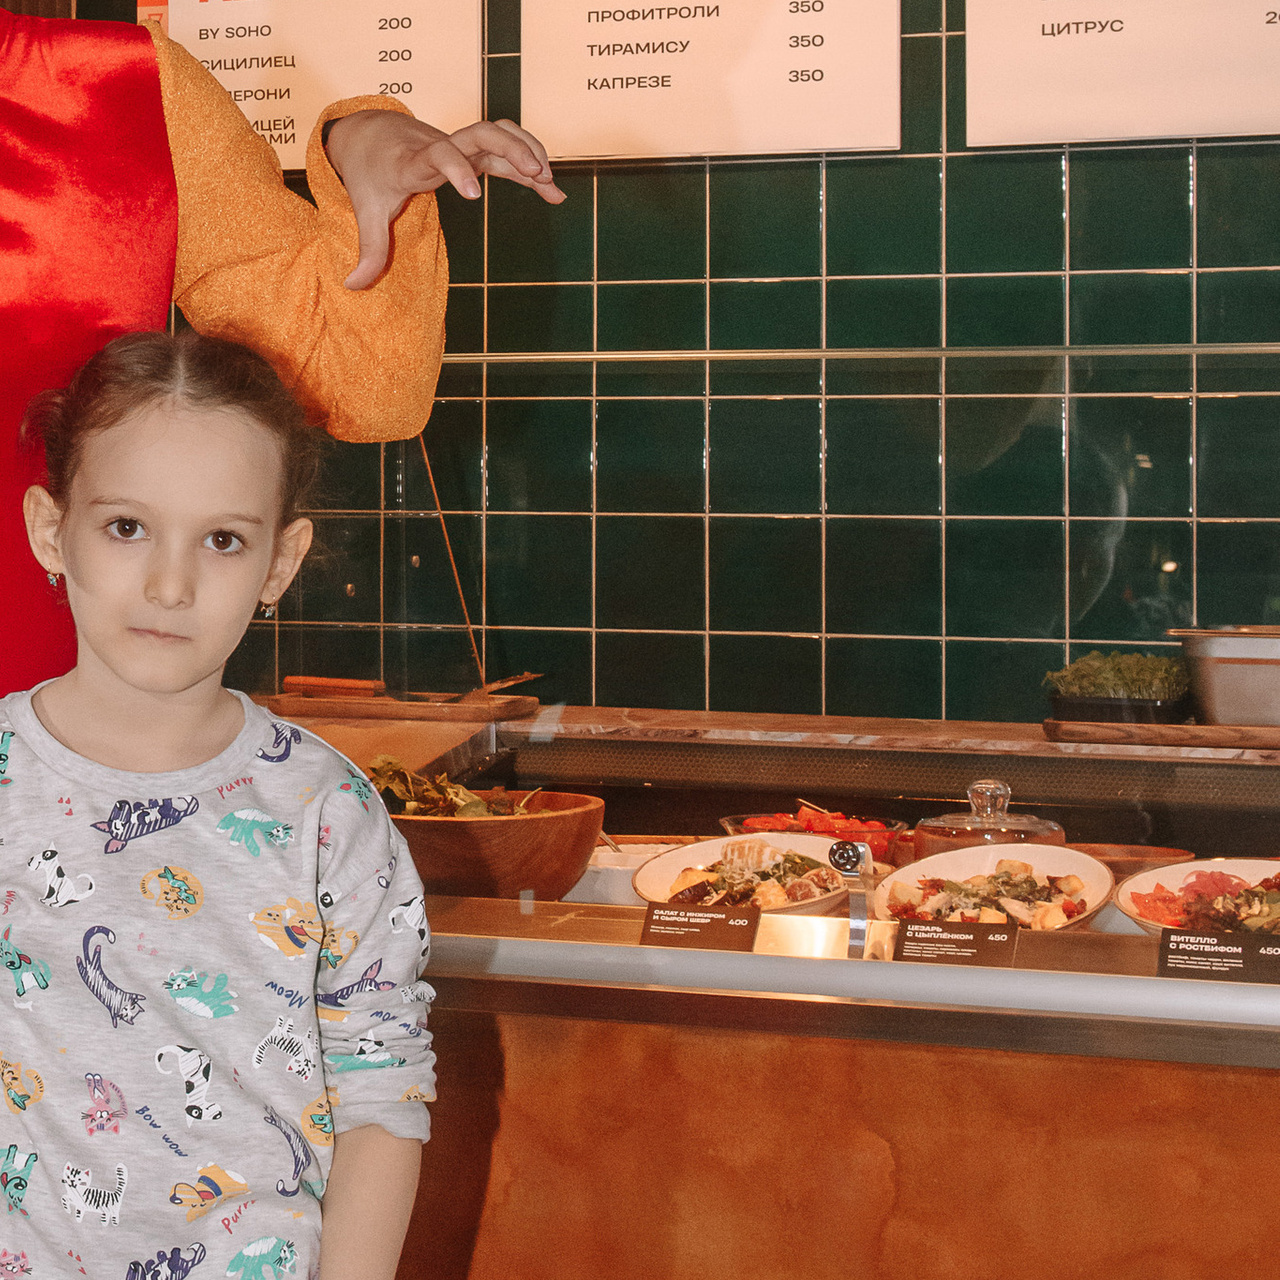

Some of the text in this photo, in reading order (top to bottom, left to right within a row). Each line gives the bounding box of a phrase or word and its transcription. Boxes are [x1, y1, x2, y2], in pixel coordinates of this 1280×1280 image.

[788, 0, 825, 13] 350
[587, 4, 720, 24] ПРОФИТРОЛИ
[378, 17, 412, 30] 200
[1041, 19, 1124, 37] ЦИТРУС
[198, 25, 272, 40] BY SOHO
[587, 39, 691, 57] ТИРАМИСУ
[788, 34, 825, 48] 350
[378, 49, 412, 62] 200
[200, 55, 296, 71] СИЦИЛИЕЦ
[587, 74, 672, 91] КАПРЕЗЕ
[788, 68, 825, 83] 350
[228, 88, 291, 102] ЕРОНИ
[379, 82, 413, 95] 200
[907, 924, 942, 932] ЦЕЗАРЬ
[914, 932, 973, 940] ЦЫПЛЁНКОМ
[987, 933, 1008, 941] 450
[1170, 935, 1218, 944] ВИТЕЛЛО
[1179, 943, 1242, 953] РОСТБИФОМ
[1259, 947, 1280, 955] 450
[265, 981, 310, 1009] Meow
[135, 1105, 161, 1128] Bow
